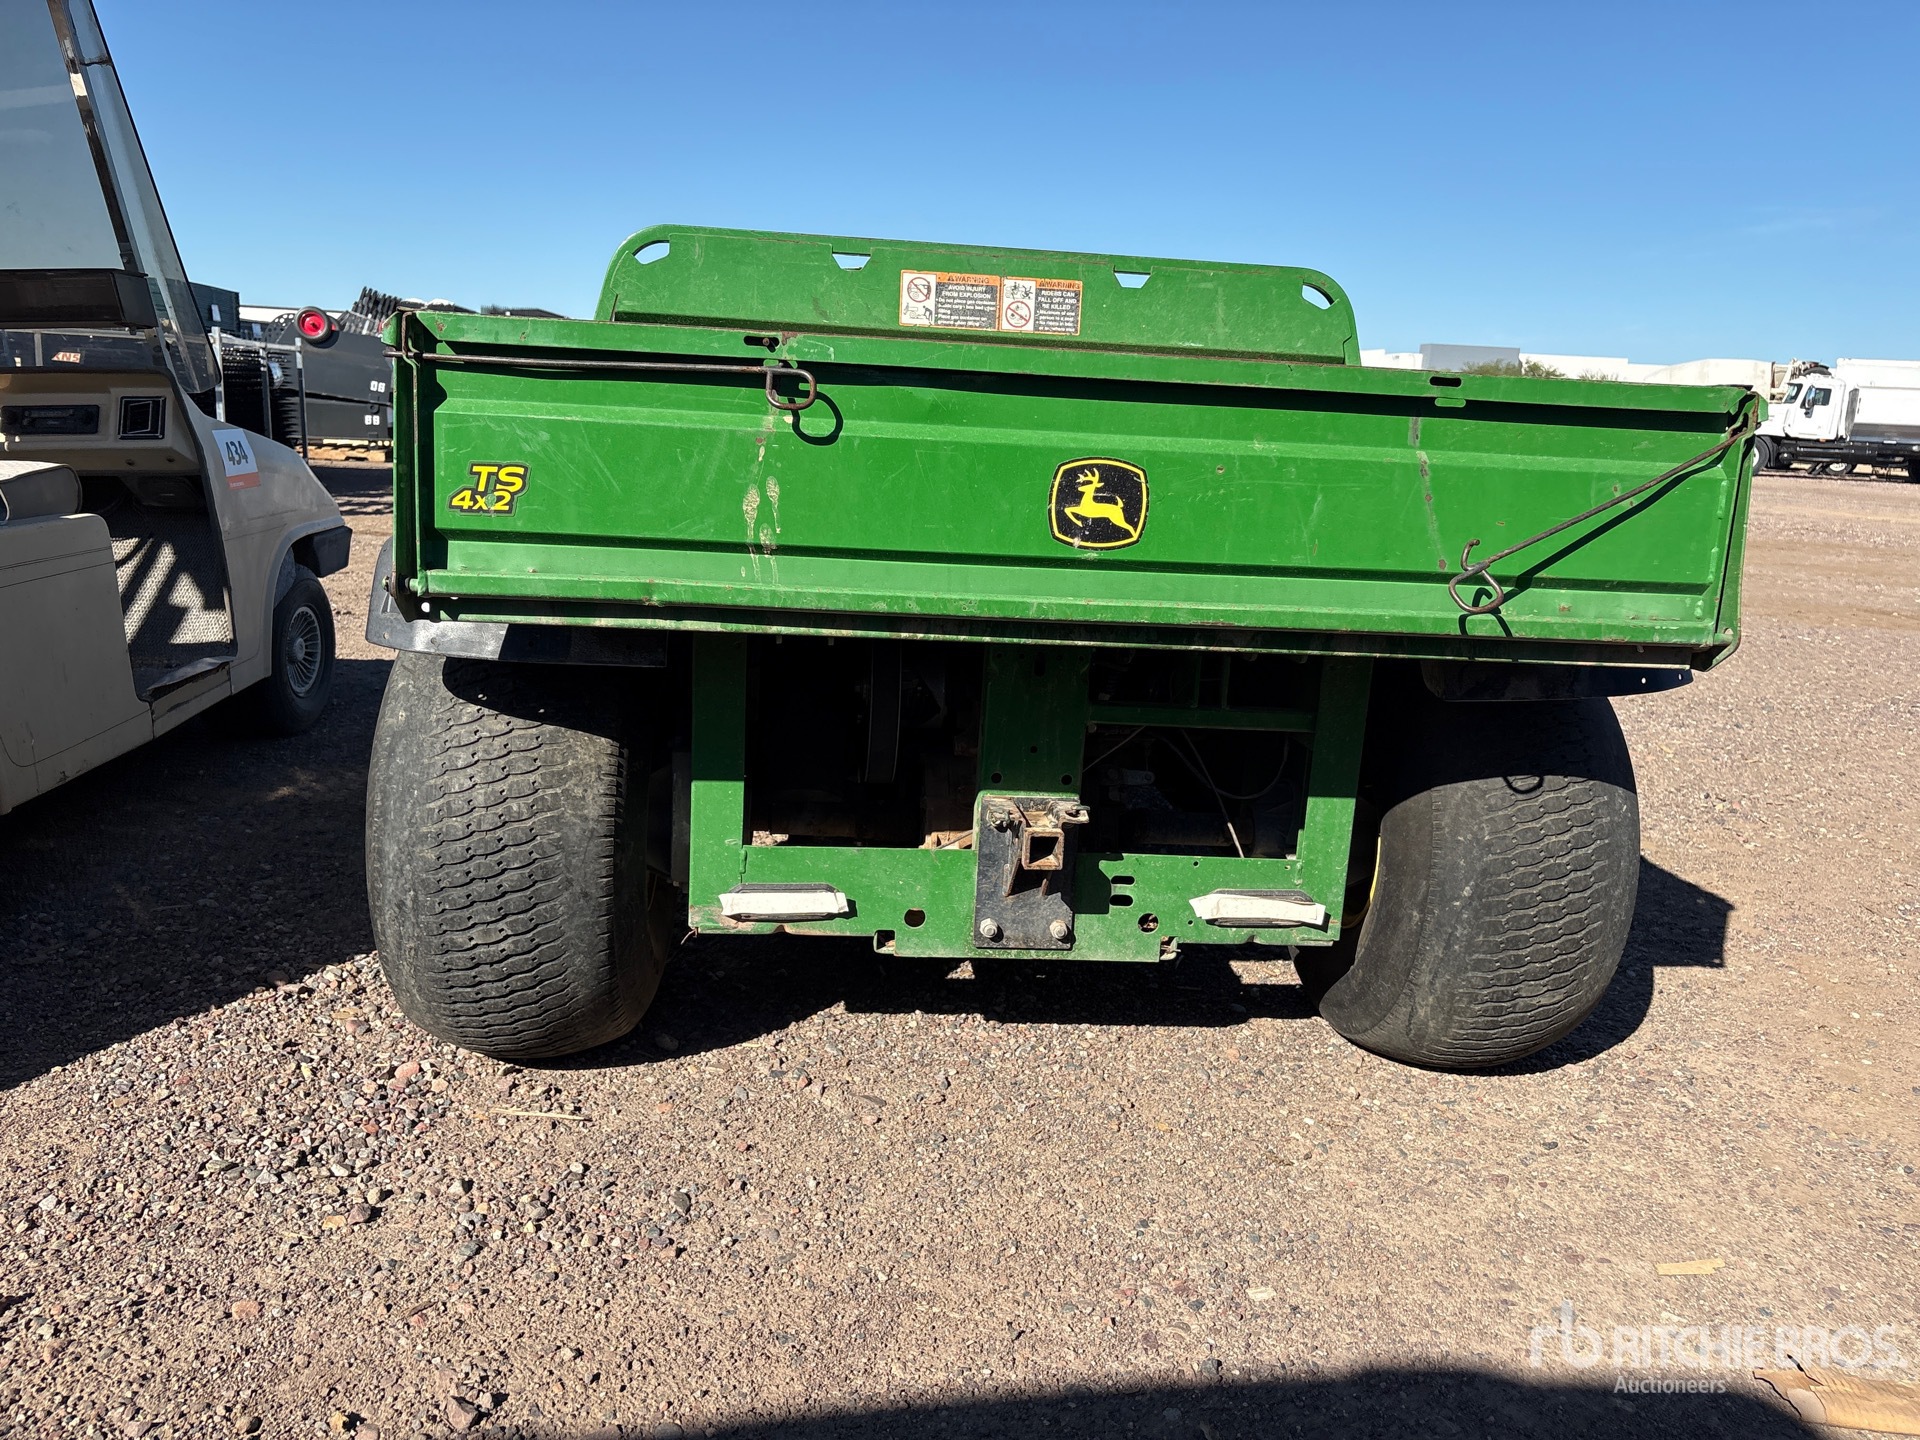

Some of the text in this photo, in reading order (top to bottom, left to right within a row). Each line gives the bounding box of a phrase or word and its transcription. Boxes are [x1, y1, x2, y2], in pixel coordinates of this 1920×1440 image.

[954, 275, 989, 284] WARNING
[225, 440, 249, 466] 434
[471, 465, 525, 492] TS
[451, 489, 512, 511] 4x2
